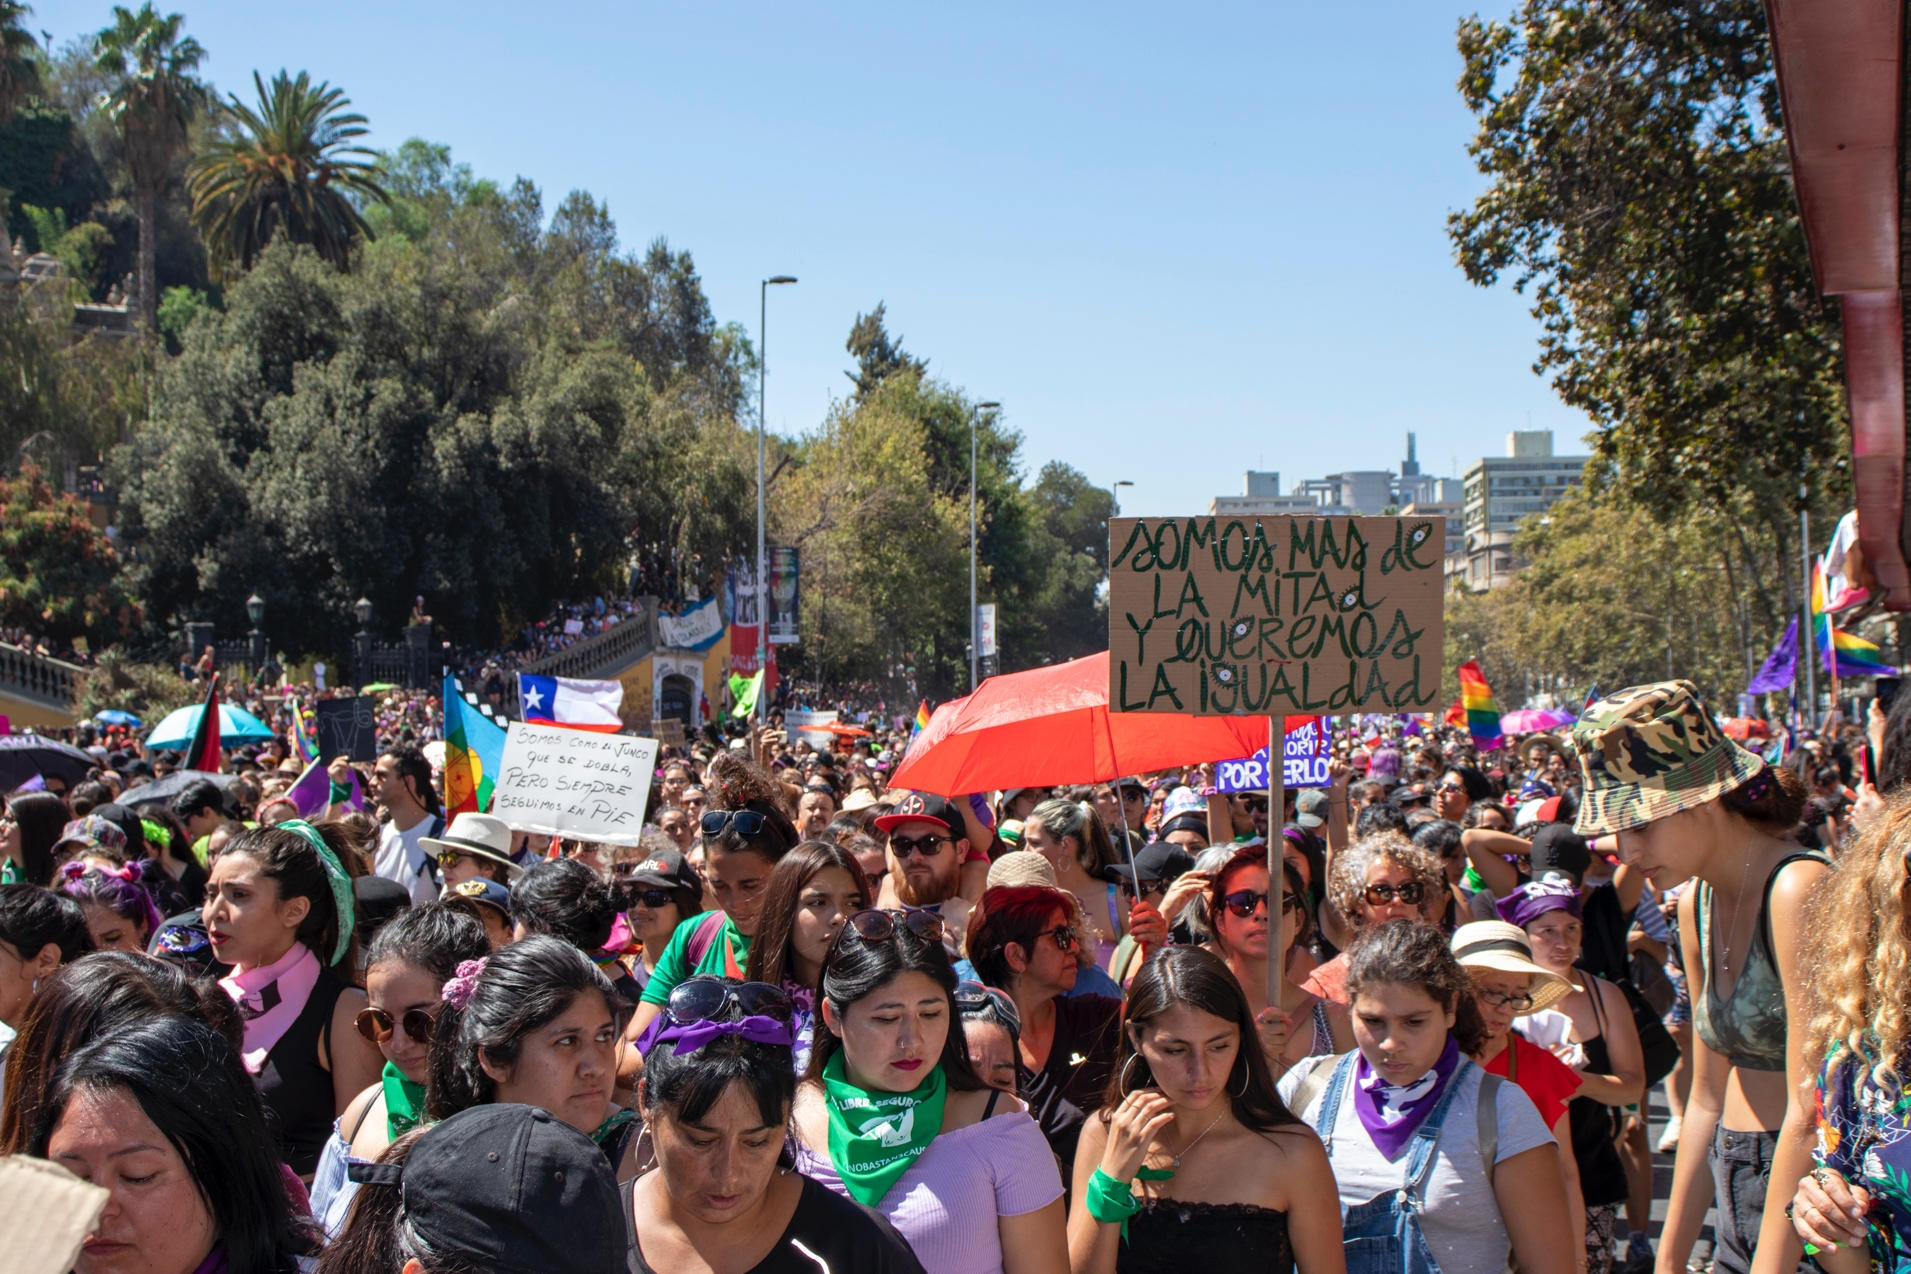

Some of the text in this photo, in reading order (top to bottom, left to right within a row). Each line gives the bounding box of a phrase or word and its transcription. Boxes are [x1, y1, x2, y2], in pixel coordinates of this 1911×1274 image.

[1112, 518, 1277, 572] SOMOS
[1290, 519, 1369, 571] MAS
[1153, 569, 1209, 619] LA
[1126, 612, 1153, 666] Y
[1120, 660, 1184, 711] LA
[516, 727, 562, 744] SOMOS
[569, 737, 598, 749] COMO
[613, 742, 649, 760] JUNCO
[506, 767, 549, 788] PERO
[557, 755, 576, 765] SE
[583, 760, 632, 778] DOBLA,
[1218, 761, 1263, 790] POR
[567, 805, 585, 817] EN
